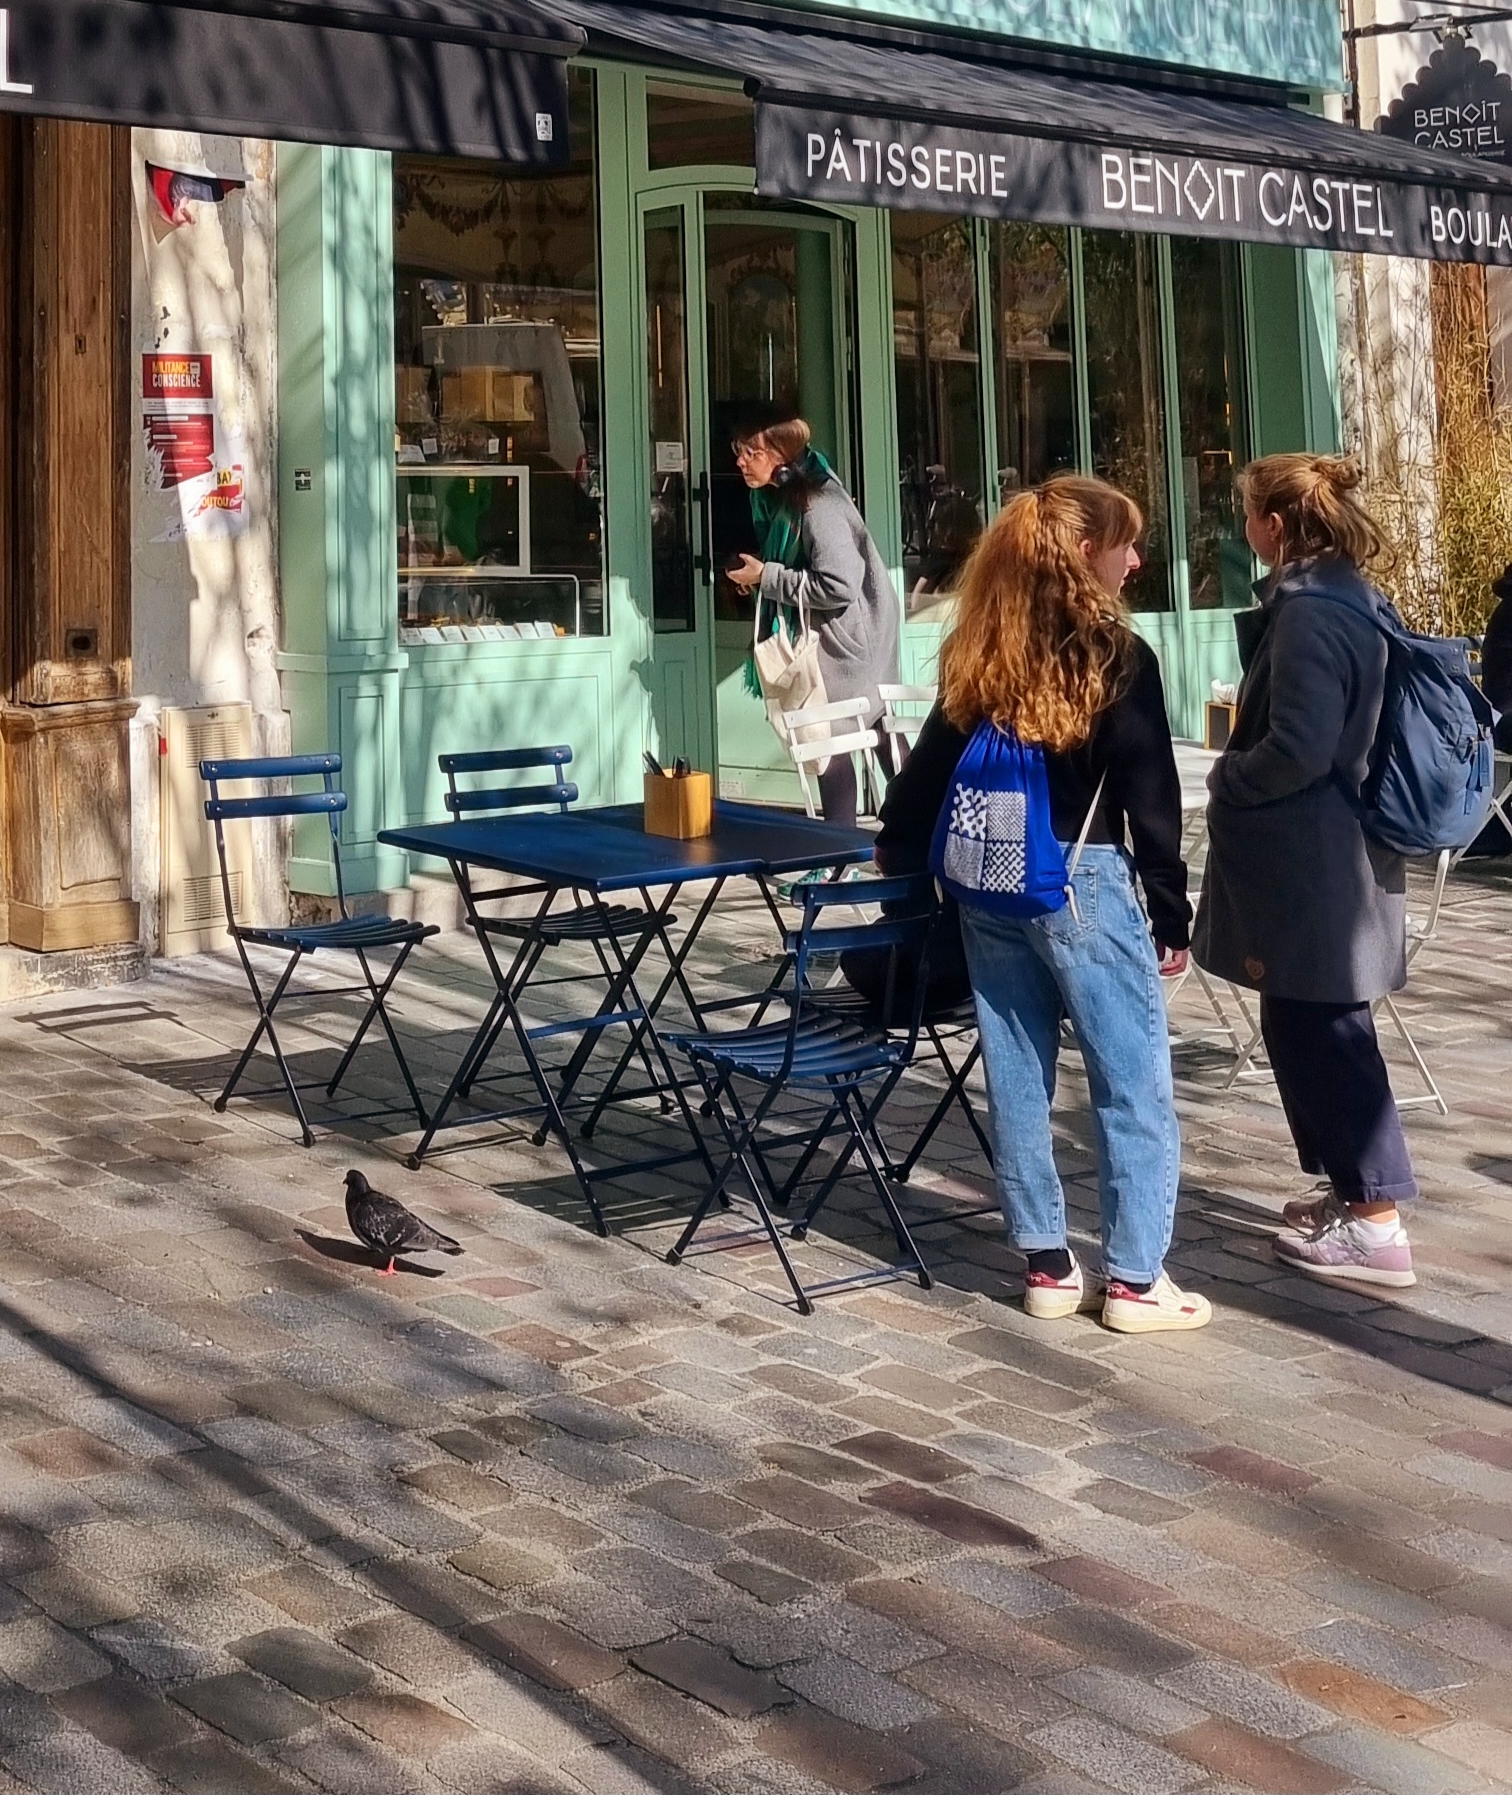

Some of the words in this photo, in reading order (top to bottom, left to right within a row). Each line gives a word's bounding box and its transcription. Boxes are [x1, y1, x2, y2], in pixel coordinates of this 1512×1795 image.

[1414, 126, 1505, 150] CASTEL
[806, 127, 1008, 198] PÂTISSERIE
[1258, 171, 1394, 238] CASTEL
[152, 373, 201, 388] CONSCIENCE
